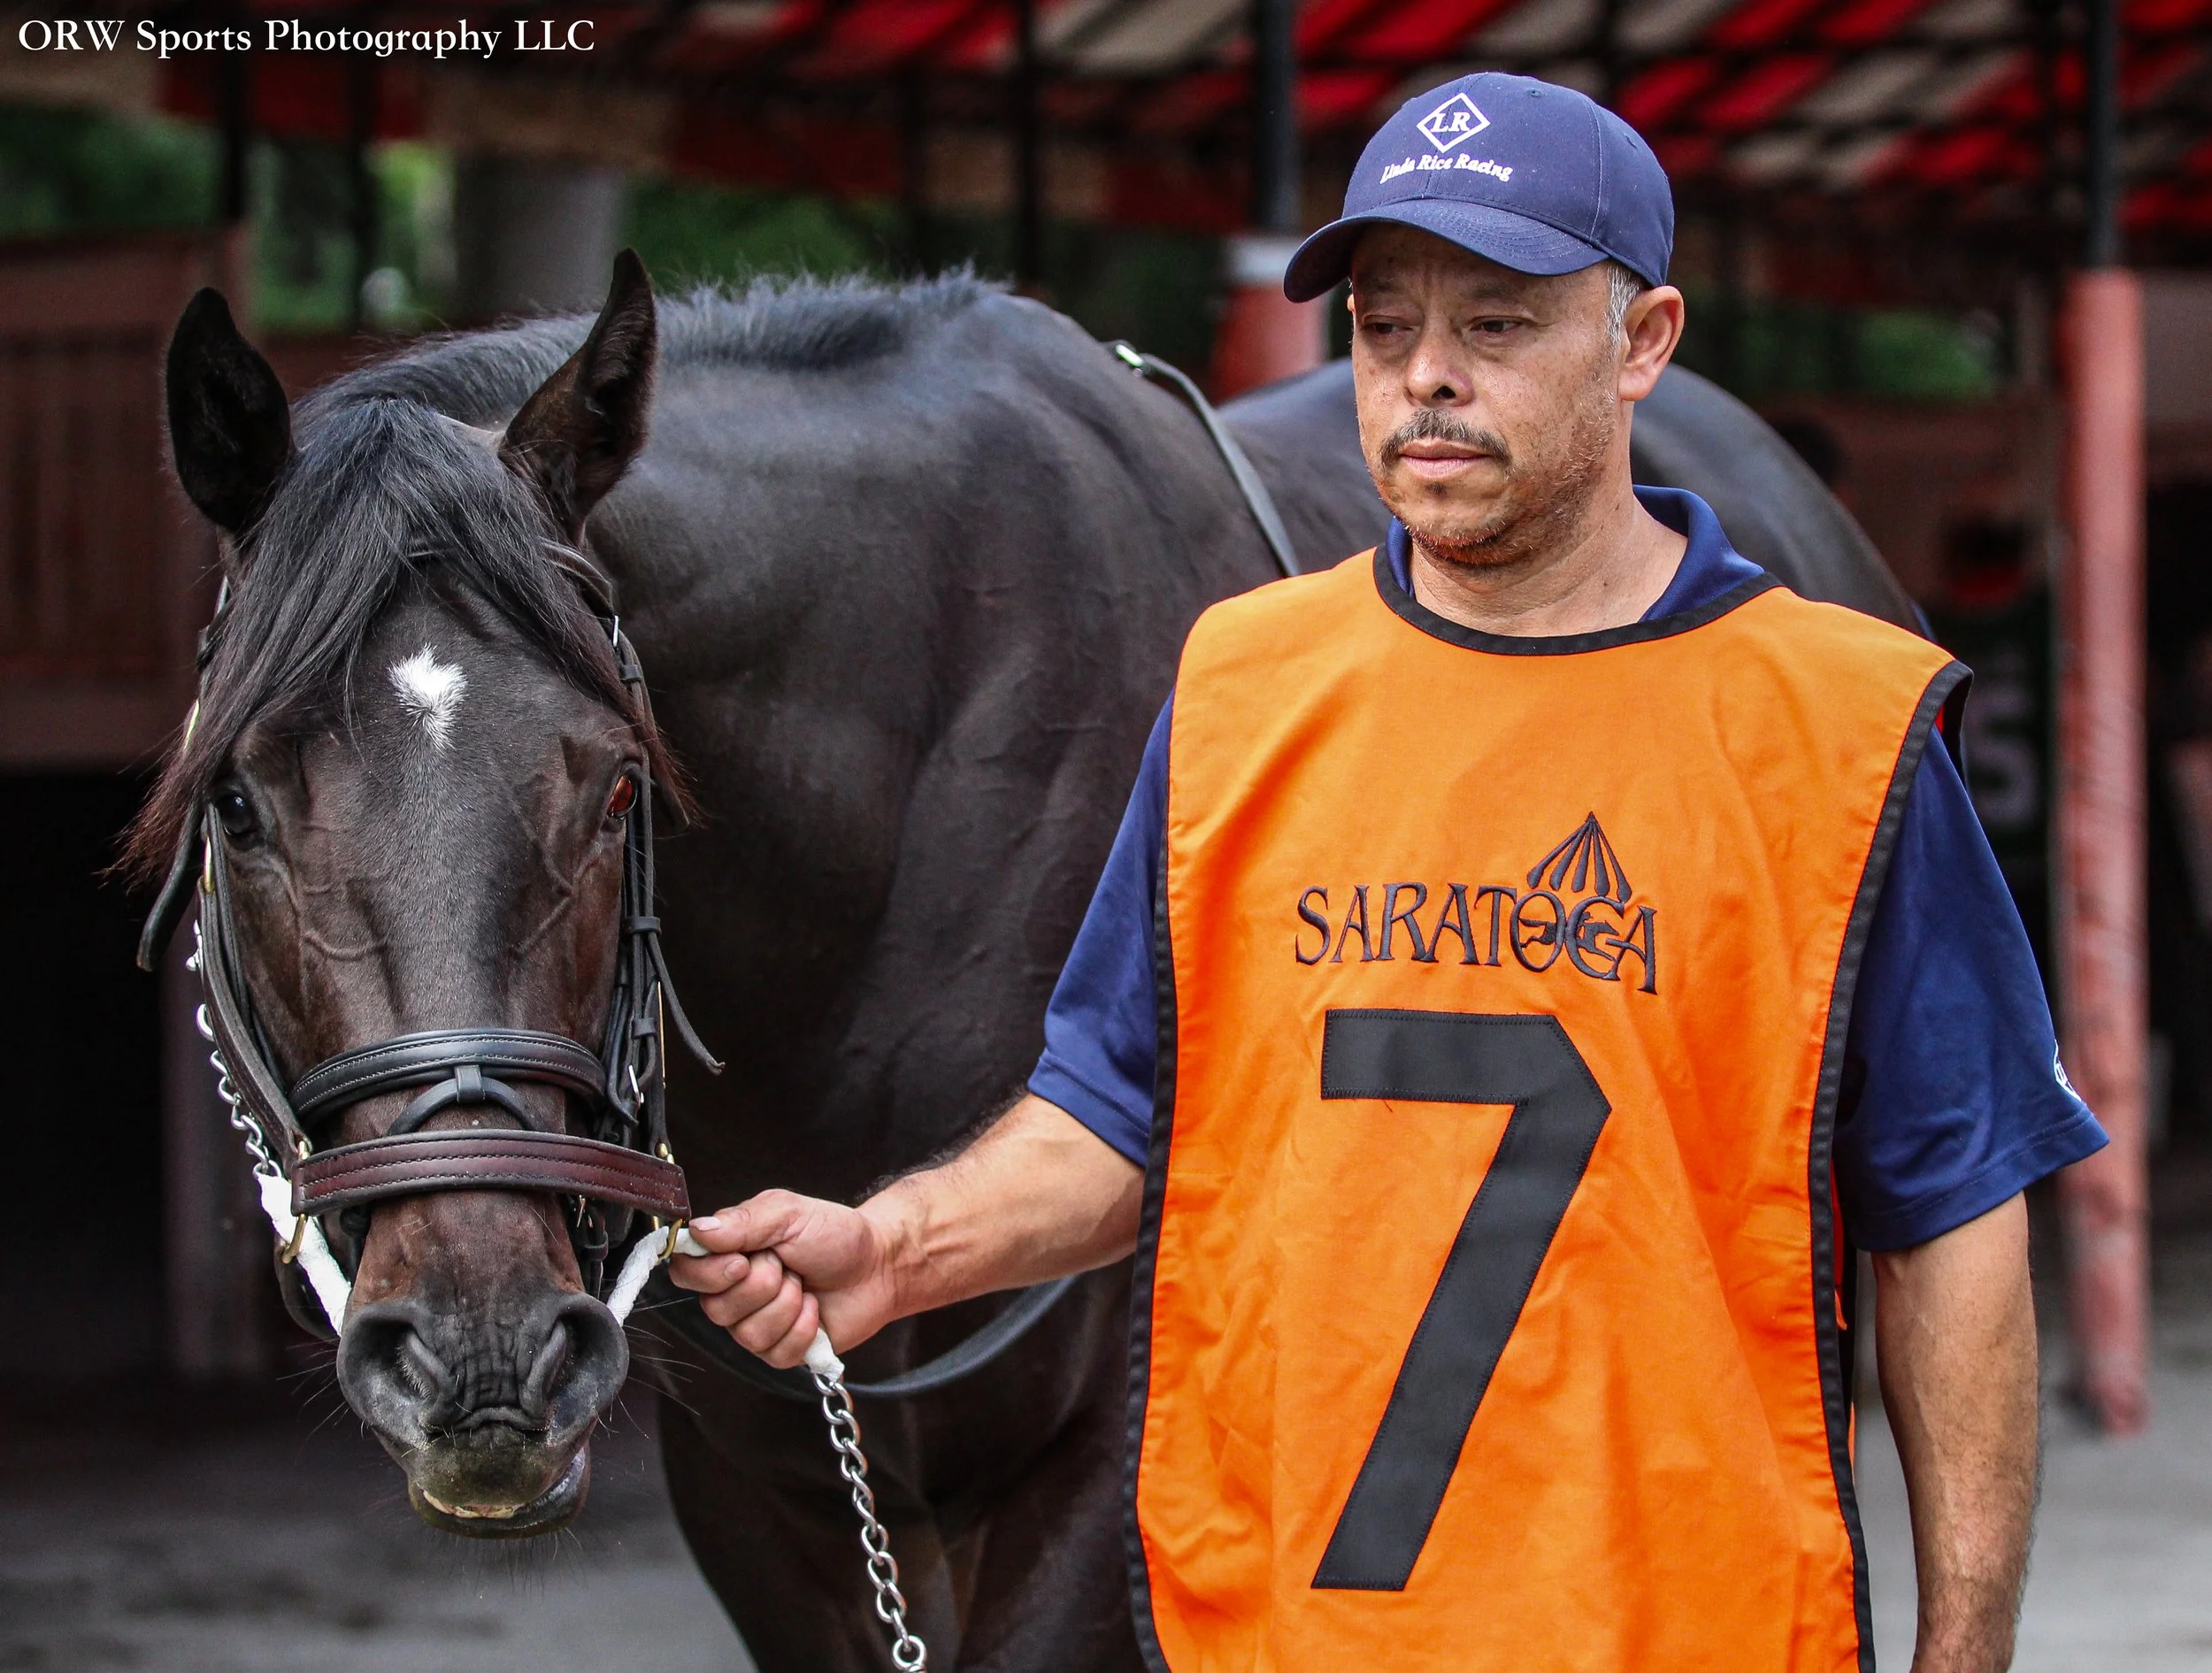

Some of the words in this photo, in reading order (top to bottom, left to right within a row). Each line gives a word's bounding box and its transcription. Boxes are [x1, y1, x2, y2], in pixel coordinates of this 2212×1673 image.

[1430, 111, 1471, 133] LR
[1416, 154, 1454, 171] Rice
[1453, 152, 1514, 182] Racing
[1294, 881, 1658, 995] SARATOGA
[1310, 1008, 1613, 1592] 7
